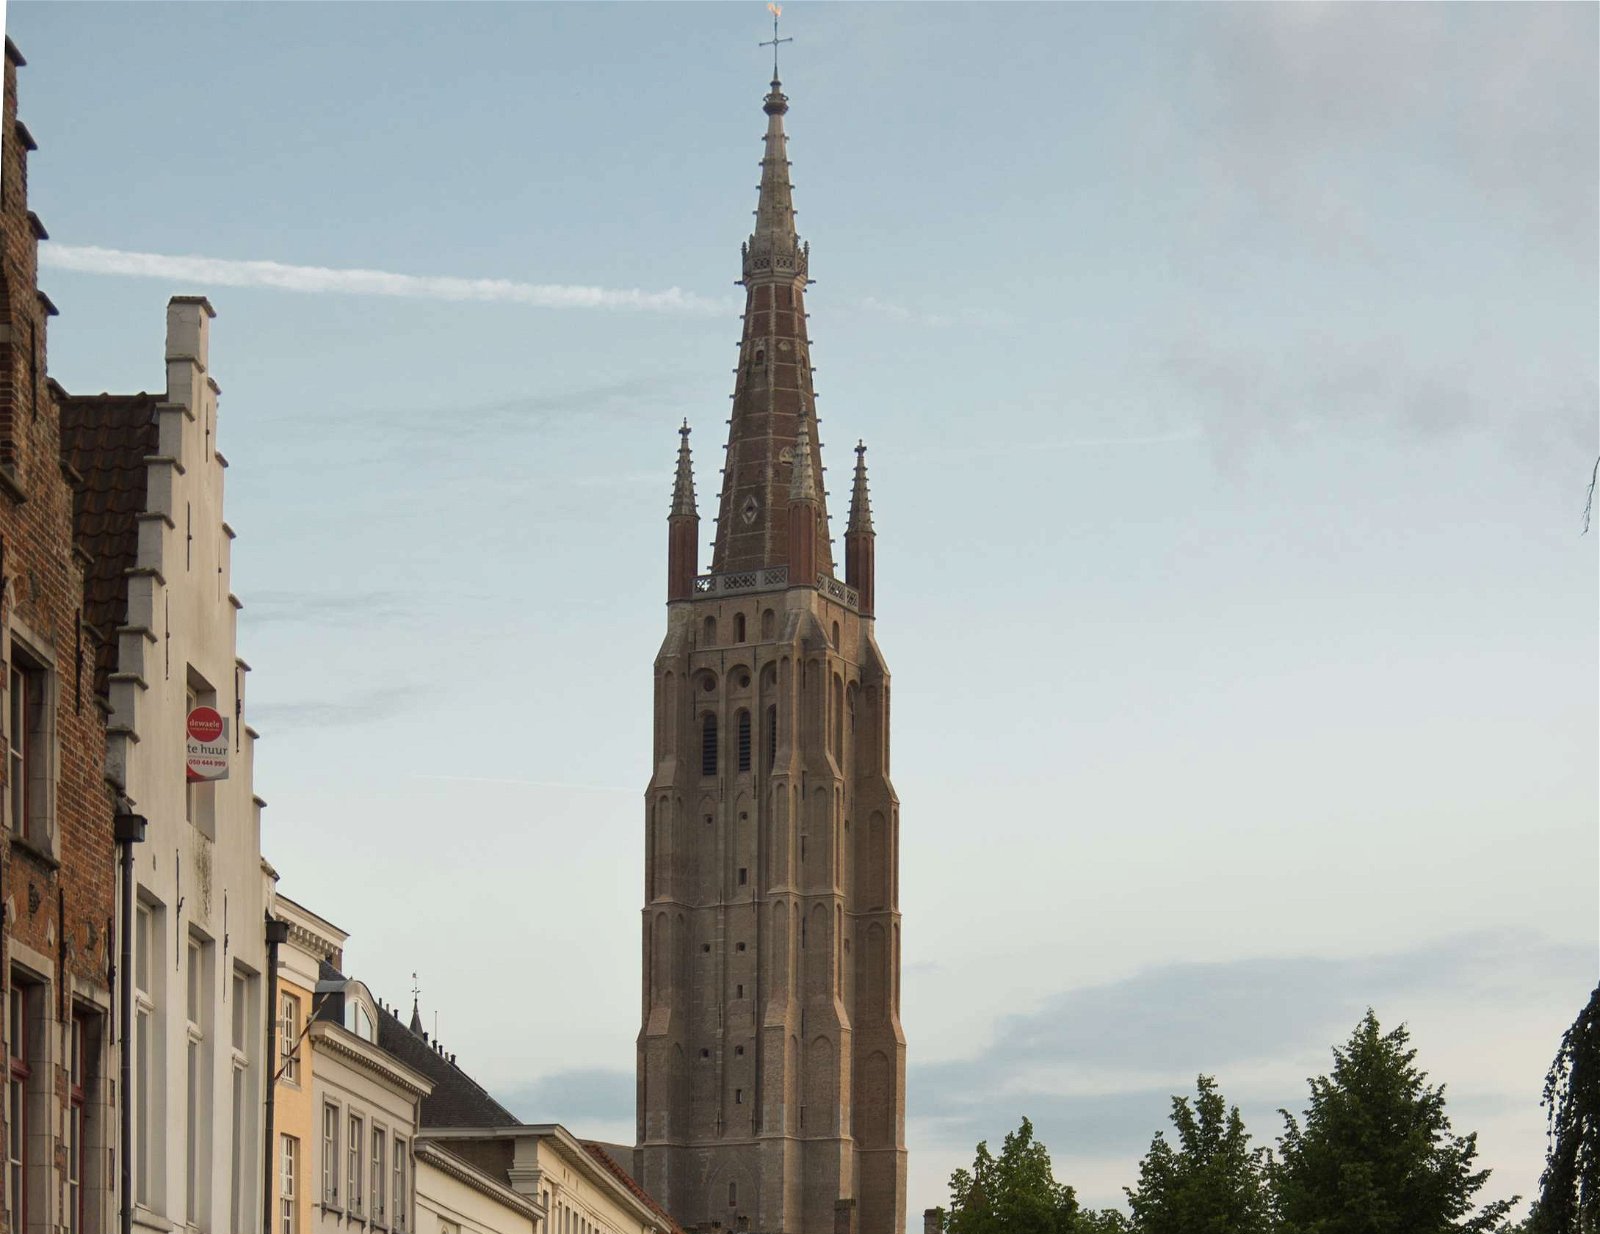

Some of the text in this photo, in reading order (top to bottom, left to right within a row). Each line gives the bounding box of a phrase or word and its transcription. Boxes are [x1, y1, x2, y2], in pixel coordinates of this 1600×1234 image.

[189, 719, 220, 728] dewaele
[187, 744, 227, 755] te huur
